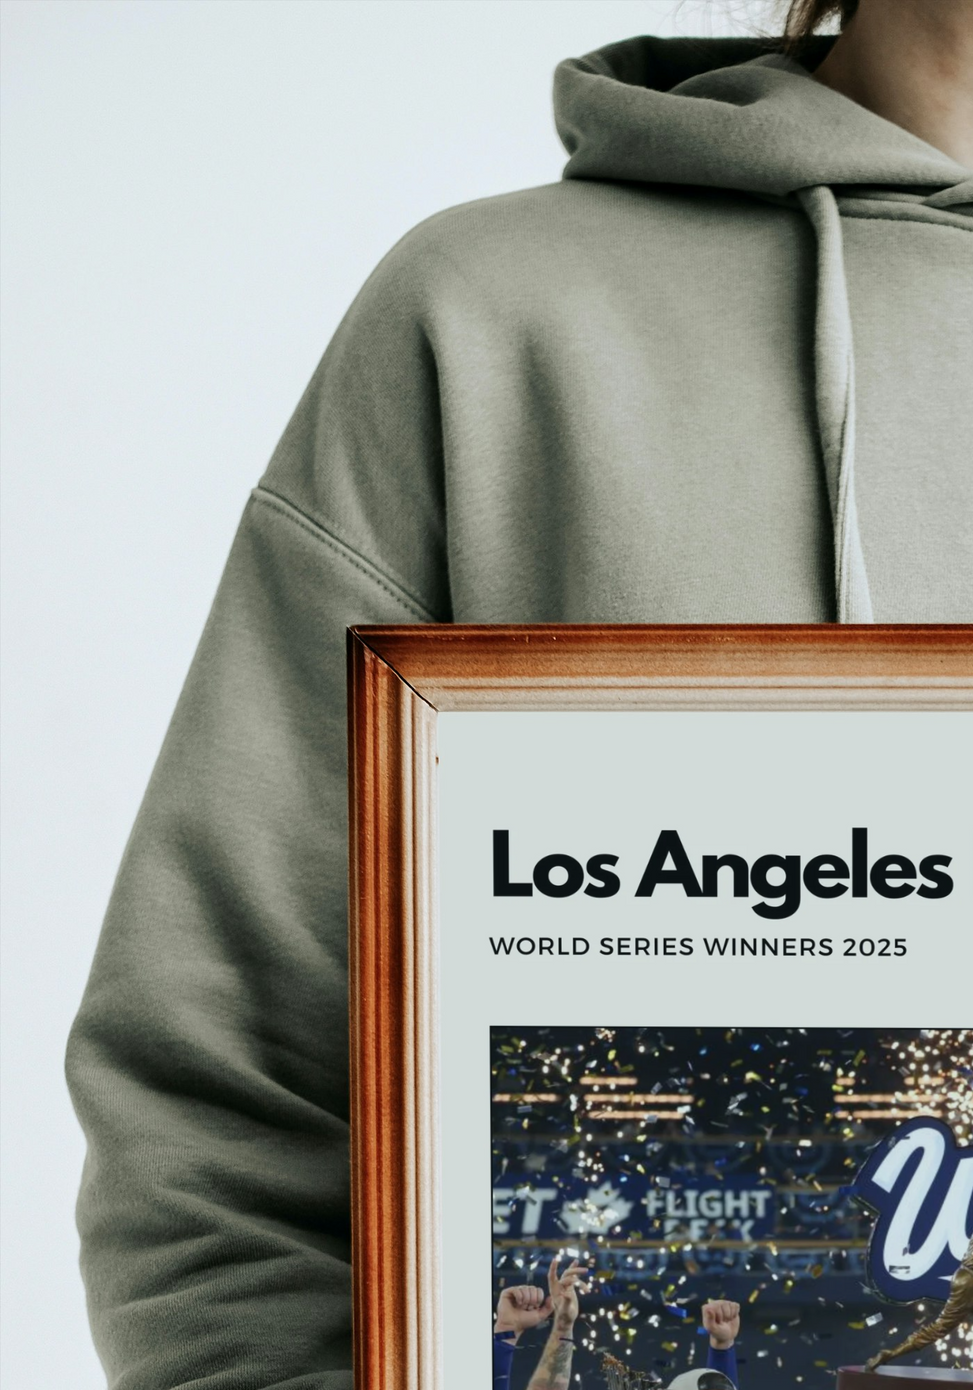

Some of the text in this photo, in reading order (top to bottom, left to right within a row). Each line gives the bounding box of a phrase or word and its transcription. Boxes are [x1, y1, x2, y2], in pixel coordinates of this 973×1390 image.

[493, 829, 620, 899] Los
[635, 827, 953, 920] Angeles
[489, 936, 907, 957] WORLD SERIES WINNERS 2025
[646, 1189, 771, 1219] FLIGHT
